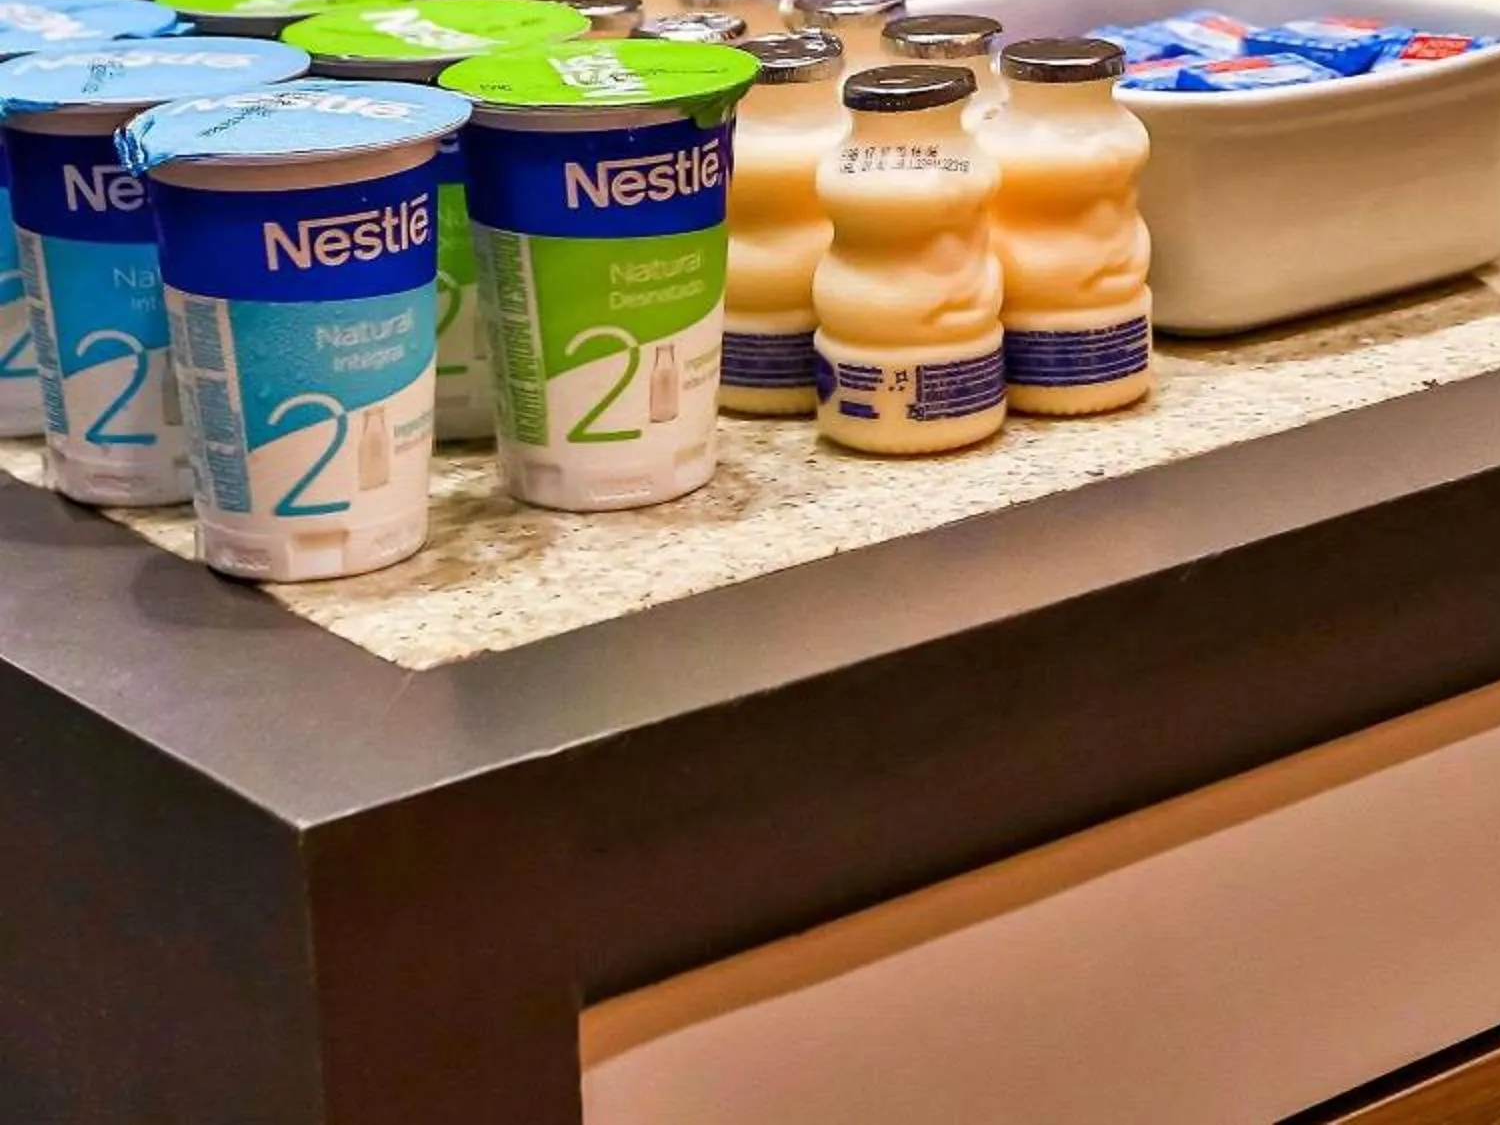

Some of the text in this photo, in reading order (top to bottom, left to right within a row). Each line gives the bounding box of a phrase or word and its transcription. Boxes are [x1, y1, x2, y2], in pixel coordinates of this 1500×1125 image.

[564, 138, 721, 210] Nestlé
[263, 193, 430, 272] Nestlé
[609, 252, 704, 286] Natural
[315, 306, 414, 351] Natural
[76, 329, 157, 446] 2
[565, 325, 642, 444] 2
[268, 392, 351, 517] 2
